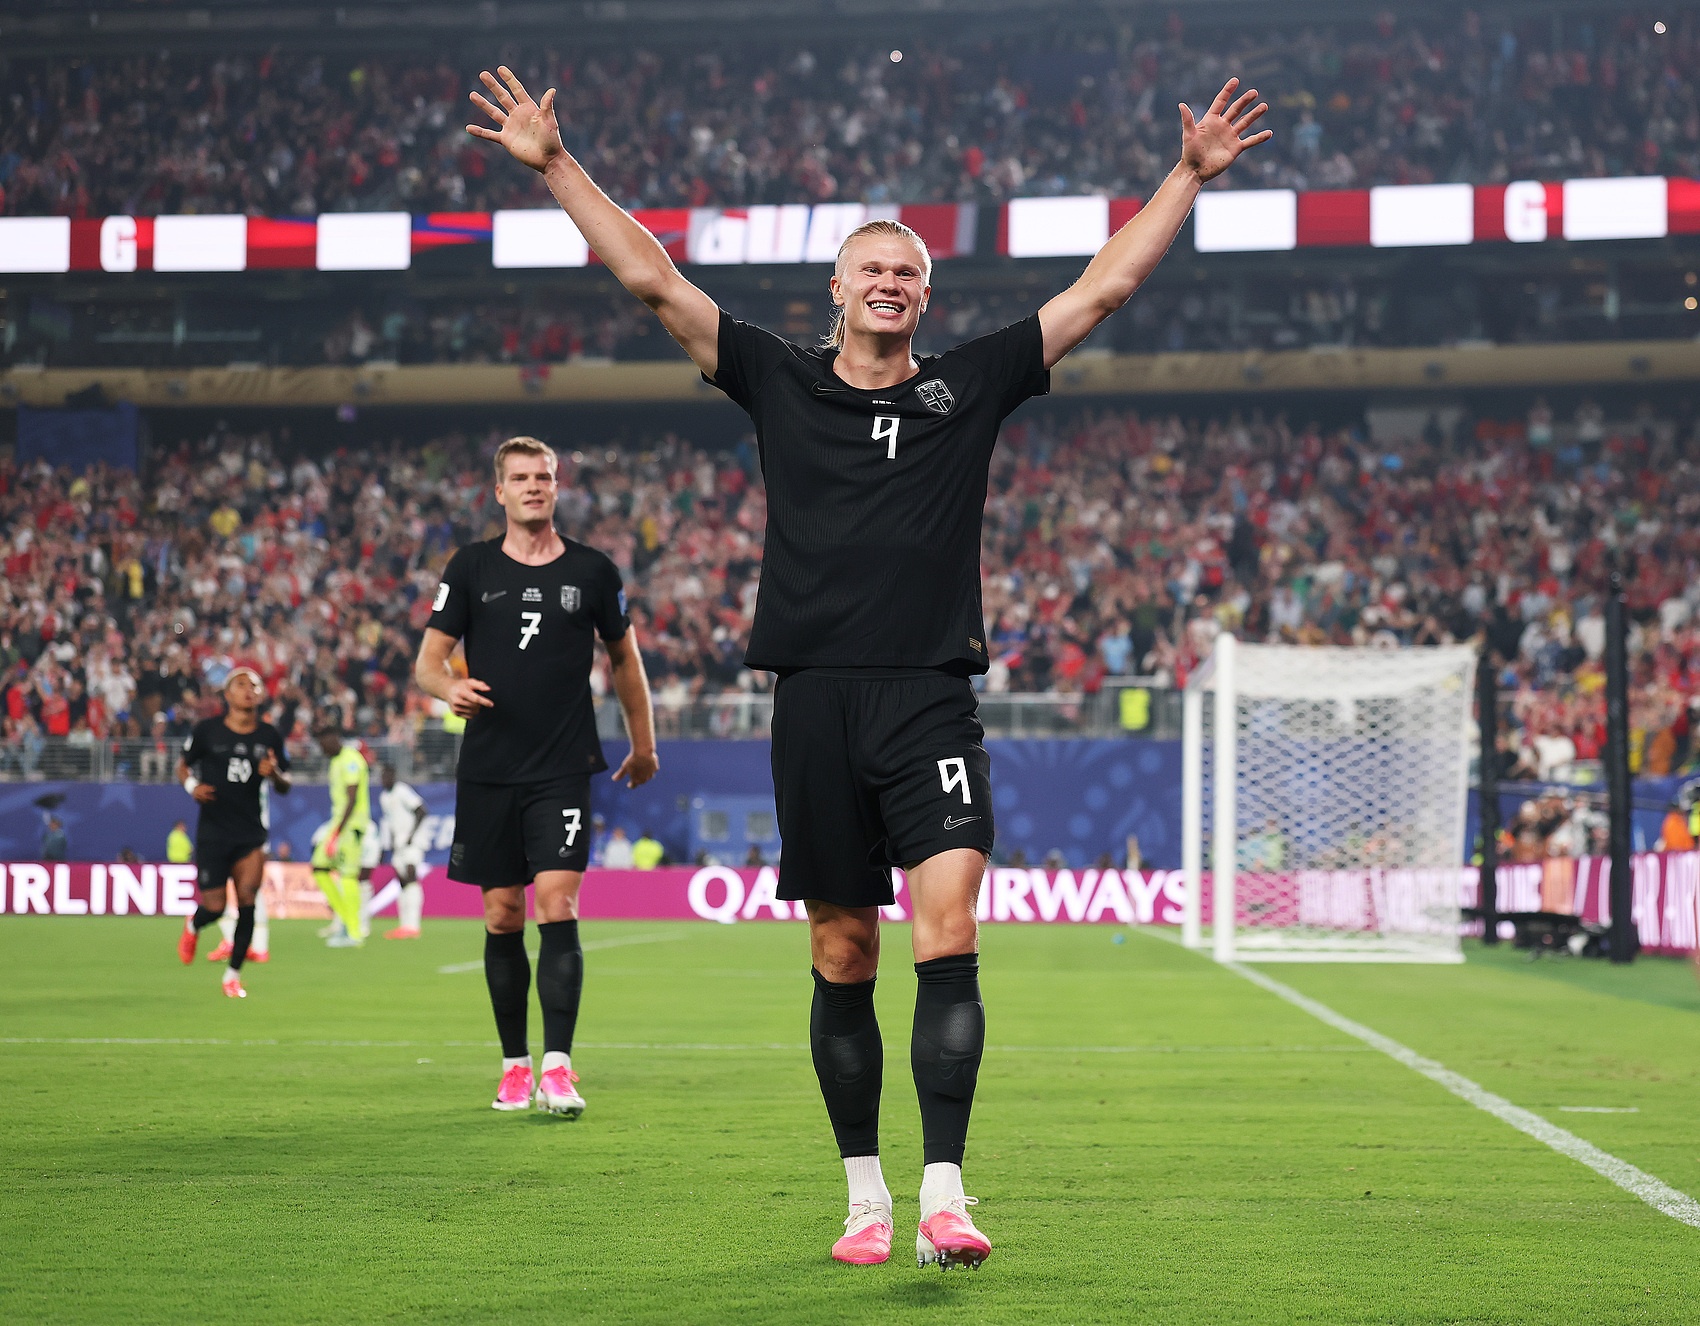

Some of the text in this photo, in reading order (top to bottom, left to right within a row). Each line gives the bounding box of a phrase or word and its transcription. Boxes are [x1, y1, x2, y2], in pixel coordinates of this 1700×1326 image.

[1503, 180, 1547, 243] G
[99, 214, 138, 272] G
[871, 415, 901, 460] 9
[518, 611, 542, 651] 7
[936, 756, 972, 805] 9
[562, 808, 582, 847] 7
[976, 867, 1186, 923] IRWAYS
